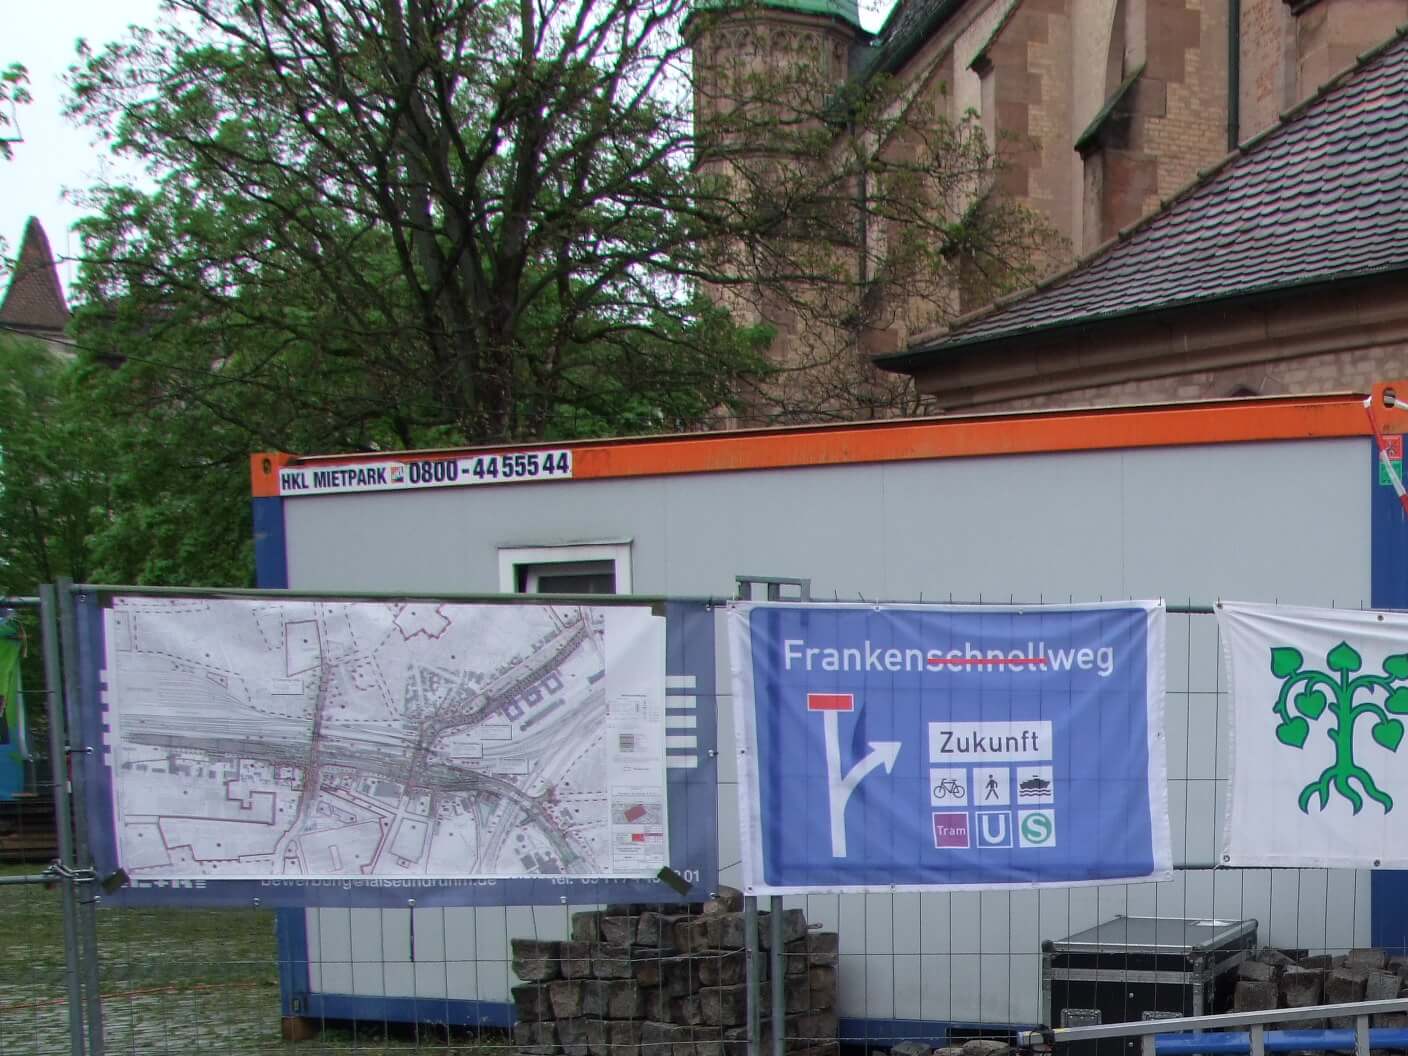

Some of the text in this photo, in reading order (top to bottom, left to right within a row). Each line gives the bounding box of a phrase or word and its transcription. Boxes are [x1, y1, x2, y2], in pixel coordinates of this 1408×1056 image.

[281, 472, 309, 491] HKL
[314, 466, 387, 489] MIETPARK
[783, 639, 1116, 677] Frankenschnellweg
[939, 730, 1039, 754] Zukunft
[936, 814, 1050, 844] Tram U S
